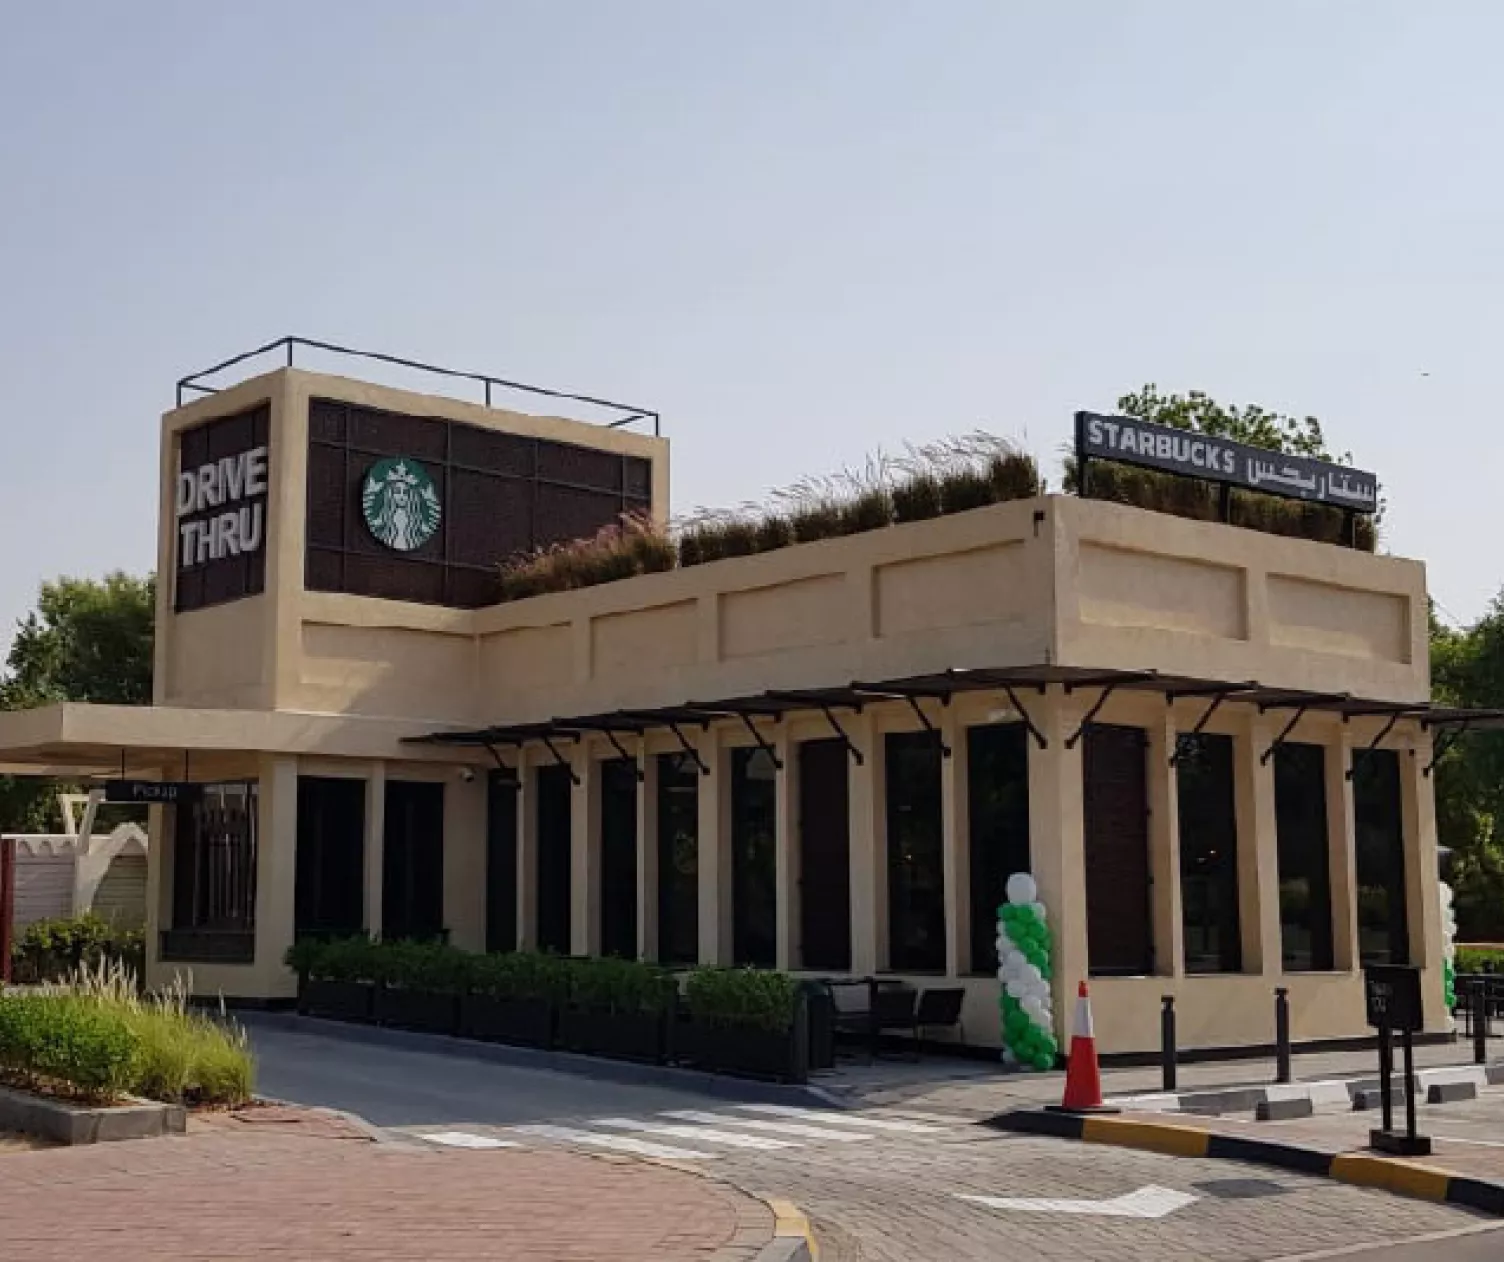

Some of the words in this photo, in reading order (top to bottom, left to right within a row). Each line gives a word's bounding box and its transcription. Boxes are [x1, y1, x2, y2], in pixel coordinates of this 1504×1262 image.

[1087, 419, 1236, 474] STARBUCKS
[176, 446, 268, 516] DRIVE
[1247, 457, 1375, 502] ستاربكس
[180, 502, 262, 567] THRU
